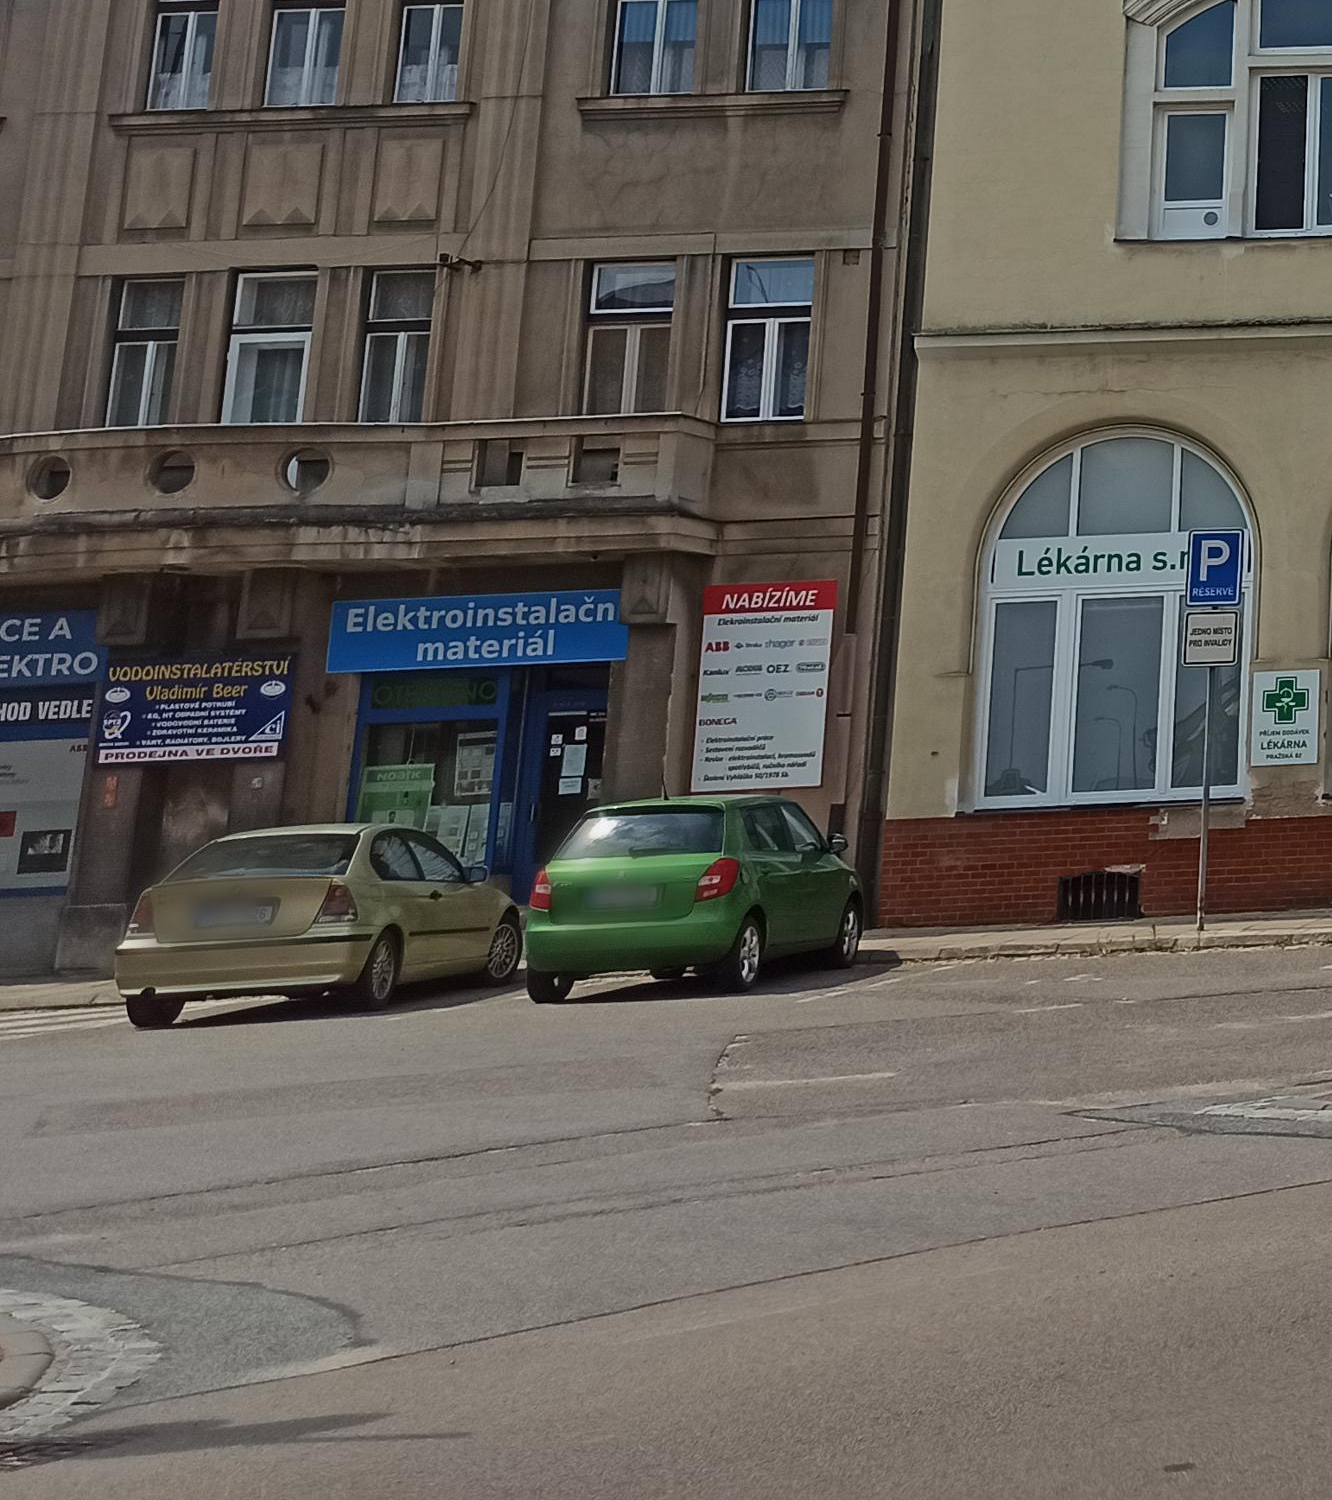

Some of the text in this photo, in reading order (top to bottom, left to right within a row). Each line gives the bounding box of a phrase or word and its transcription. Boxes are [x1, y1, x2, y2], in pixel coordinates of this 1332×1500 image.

[1017, 546, 1189, 576] Lékárna s.r
[1199, 539, 1231, 581] P
[721, 587, 818, 610] NABÍZÍME
[346, 596, 615, 633] Elektroinstalačn
[0, 617, 72, 642] CE A
[416, 630, 555, 662] materiál
[705, 641, 730, 653] ABB
[766, 664, 790, 674] OEZ
[145, 683, 248, 701] Vladimír Beer
[38, 700, 93, 719] VEDLE
[104, 750, 188, 761] PRODEJNA
[196, 747, 216, 756] VE
[1260, 739, 1308, 750] LÉKÁRNA
